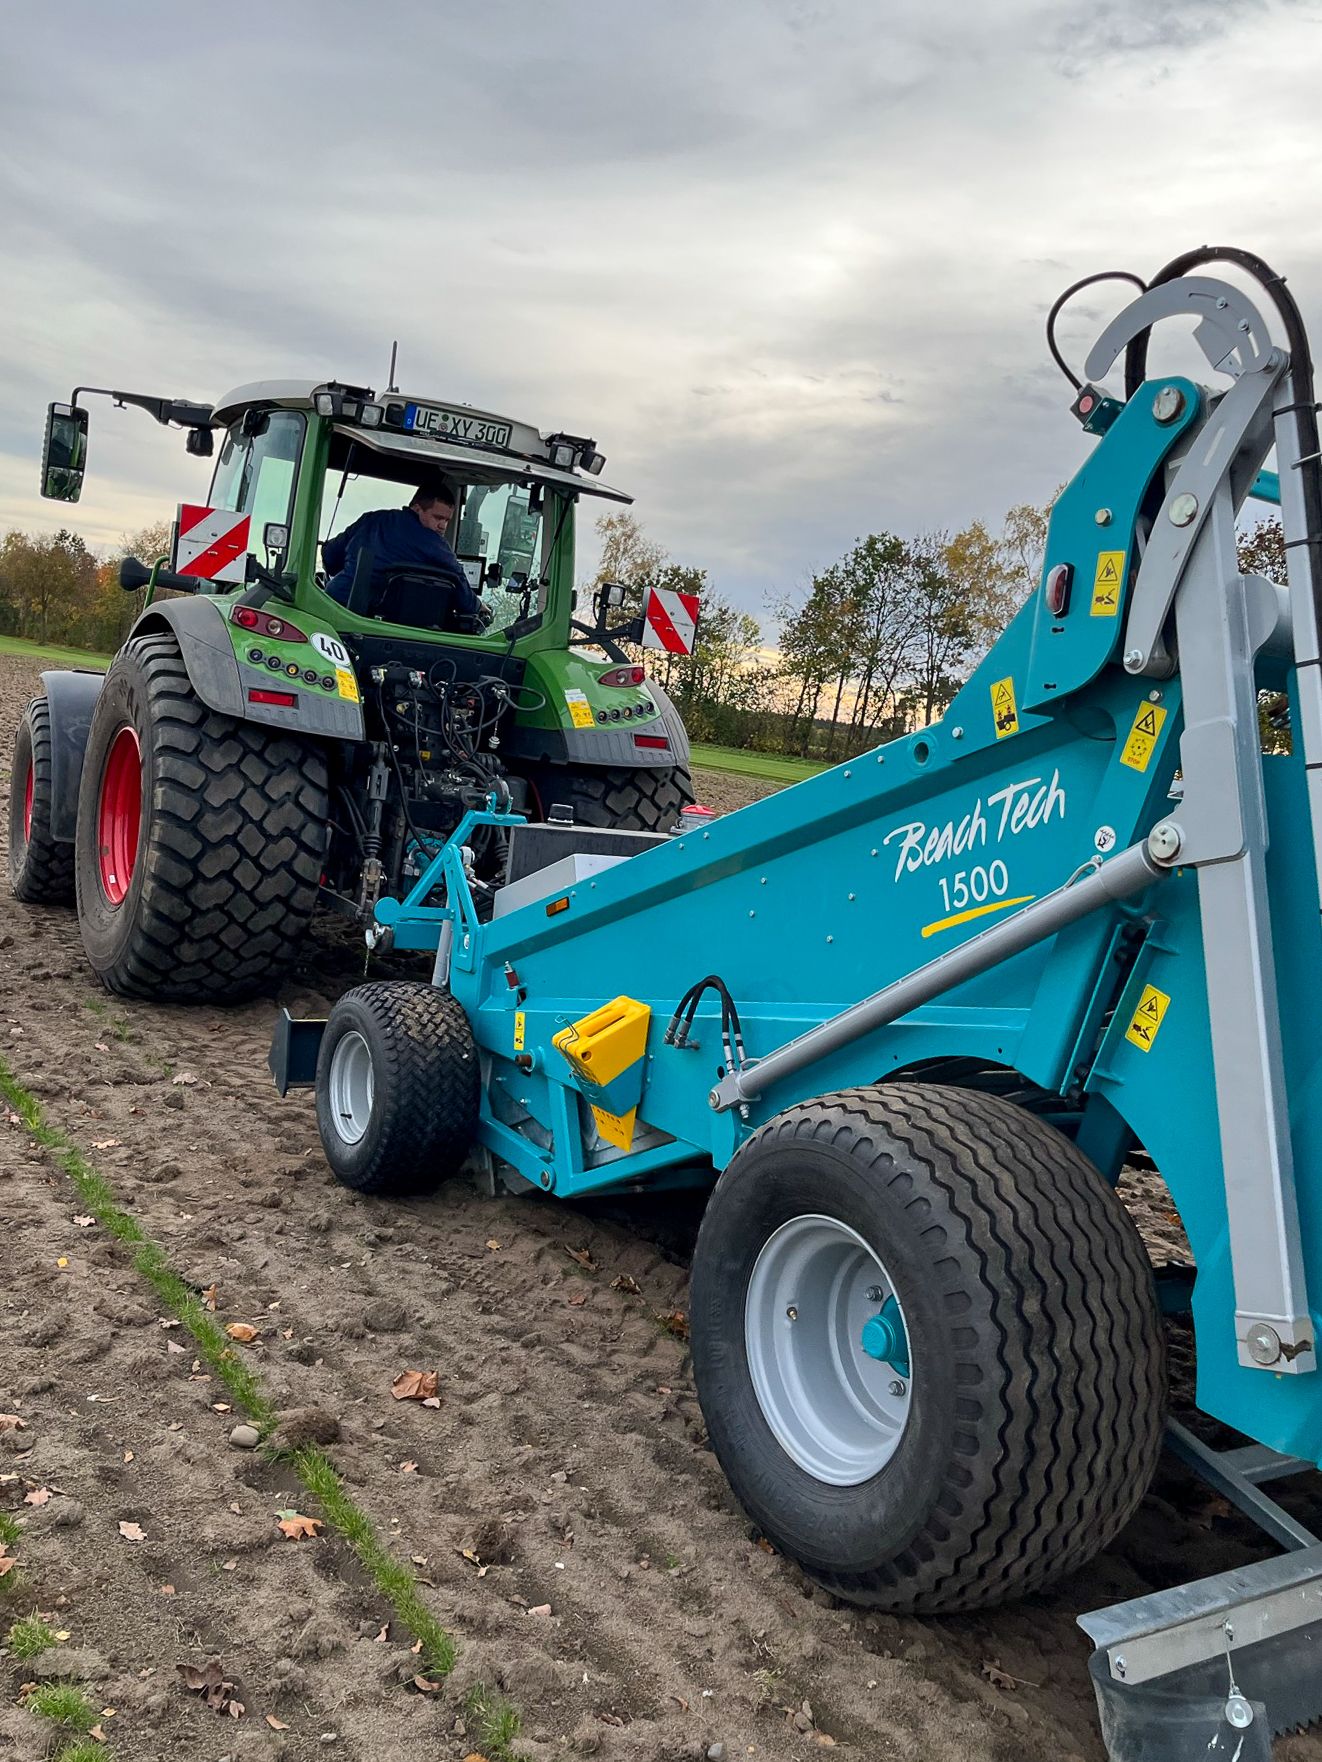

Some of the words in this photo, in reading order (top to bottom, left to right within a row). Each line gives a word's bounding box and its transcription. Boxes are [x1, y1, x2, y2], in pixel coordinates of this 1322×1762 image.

[416, 410, 439, 430] UE
[449, 418, 473, 438] XY
[475, 422, 506, 444] 300
[320, 637, 344, 661] 40
[883, 798, 986, 883] Beach
[987, 768, 1065, 843] Tech
[939, 859, 1008, 911] 1500
